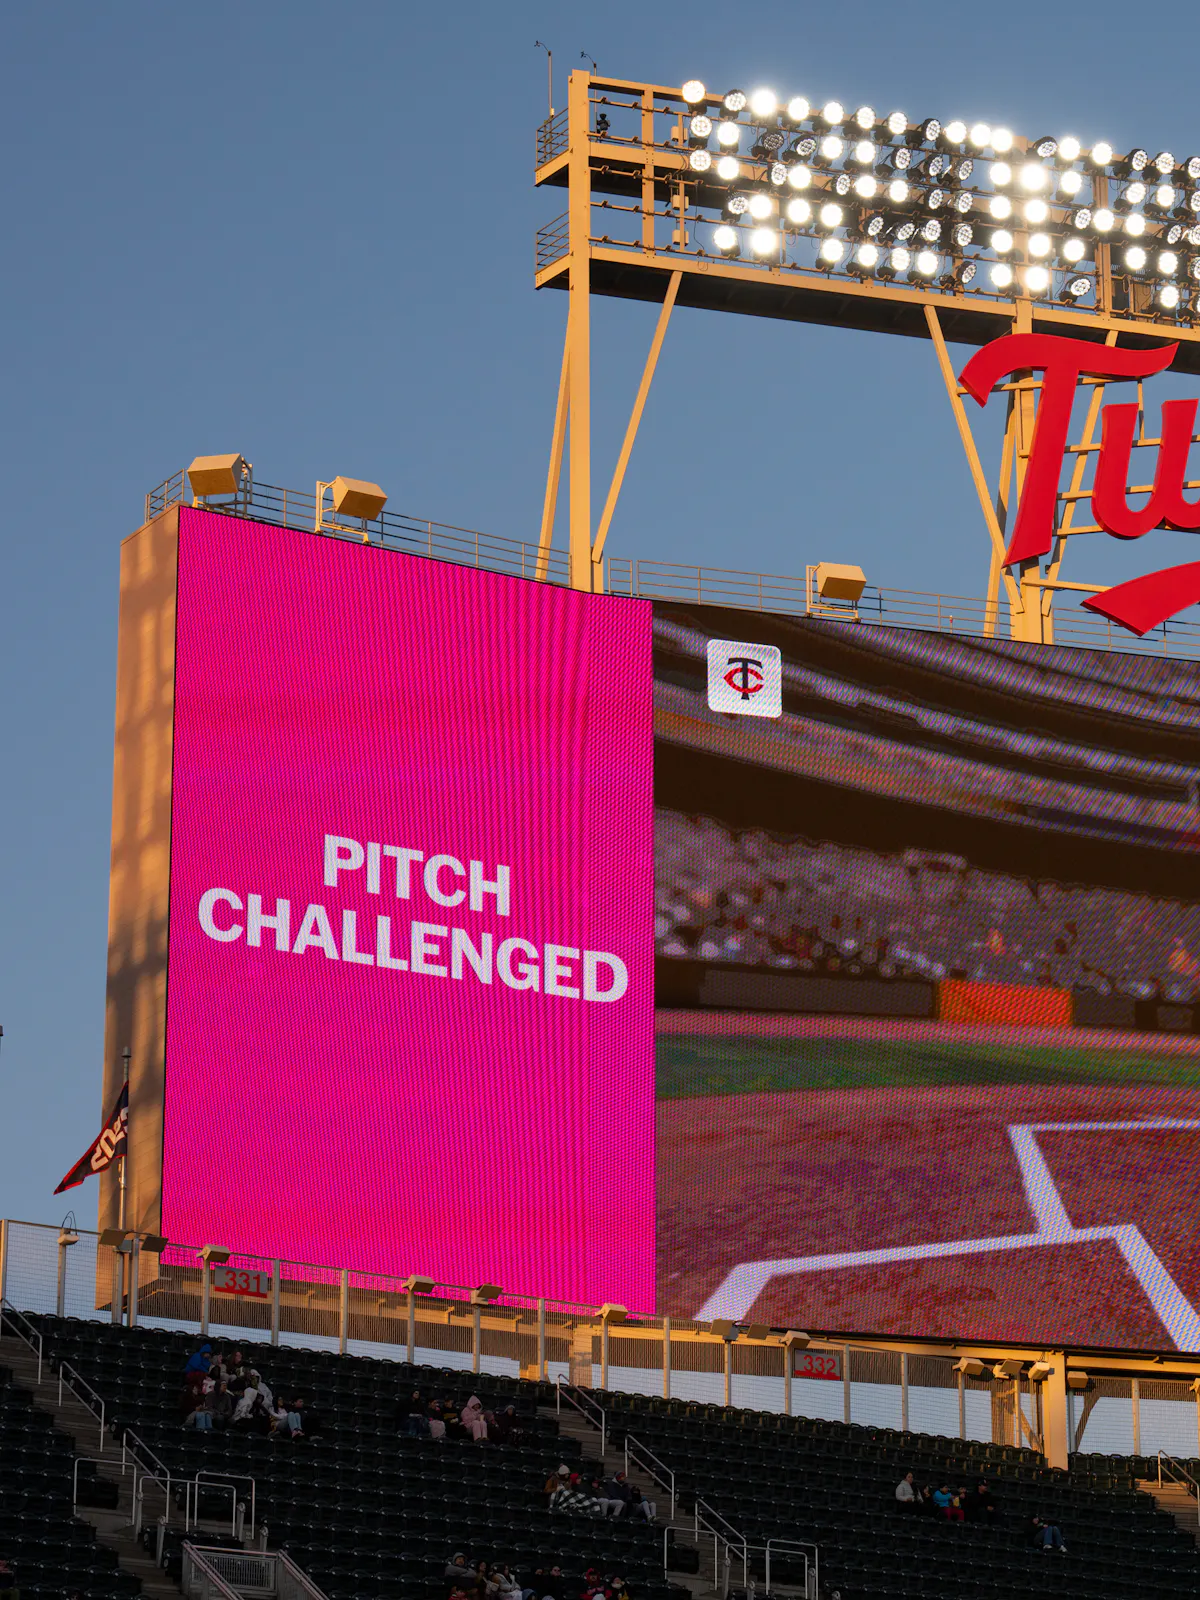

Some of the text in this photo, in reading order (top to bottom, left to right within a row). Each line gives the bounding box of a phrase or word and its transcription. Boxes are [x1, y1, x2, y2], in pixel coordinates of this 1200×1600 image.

[324, 833, 511, 917] PITCH
[198, 887, 629, 1003] CHALLENGED
[225, 1270, 261, 1293] 331
[803, 1354, 836, 1375] 332
